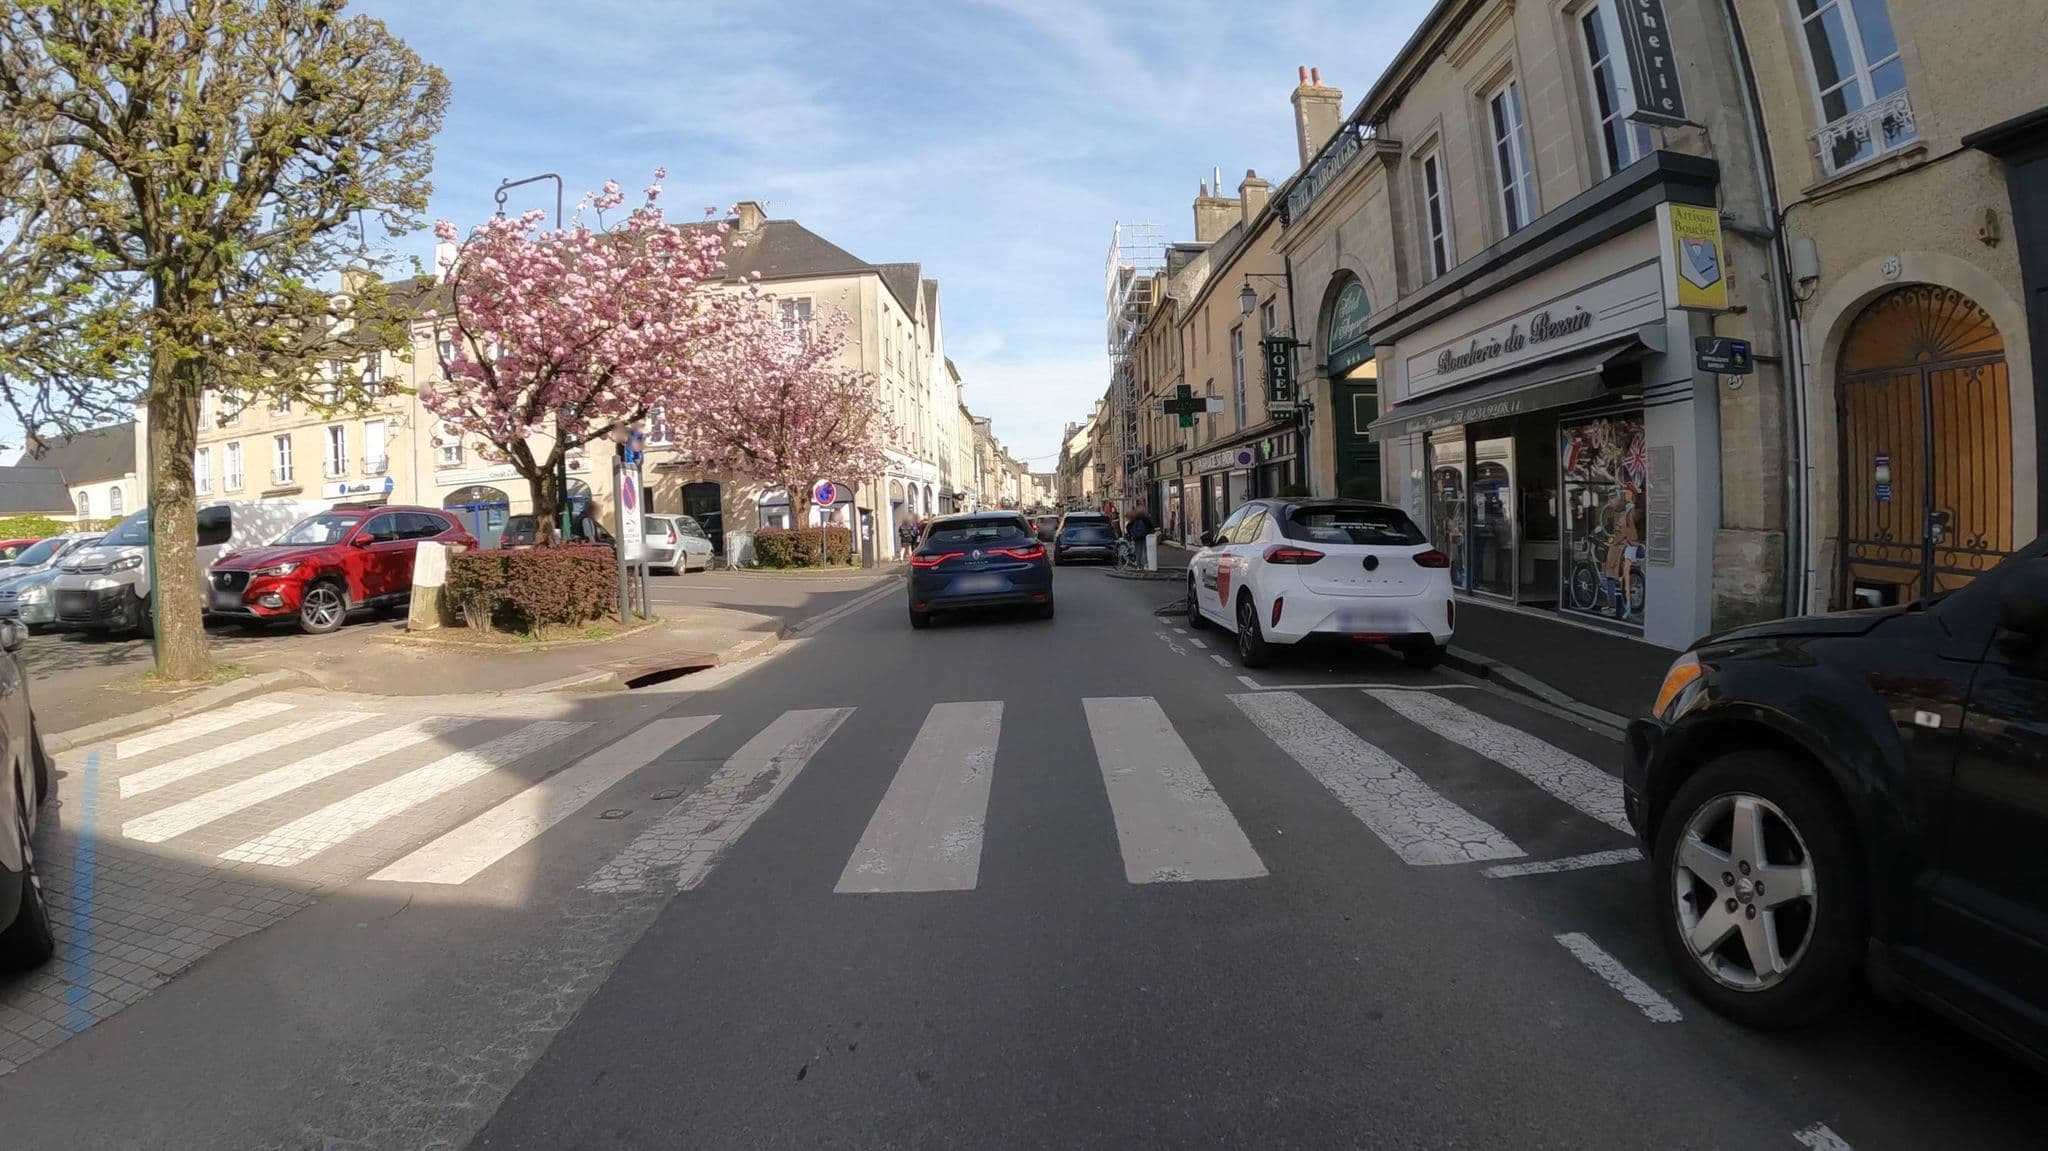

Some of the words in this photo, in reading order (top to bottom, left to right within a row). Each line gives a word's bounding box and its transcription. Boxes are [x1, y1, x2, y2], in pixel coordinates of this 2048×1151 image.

[1676, 208, 1713, 223] Artisan
[1674, 220, 1716, 237] Boucher
[1437, 338, 1502, 375] Boucherie
[1505, 324, 1526, 353] du
[1529, 305, 1593, 345] Bessin
[347, 484, 371, 493] Audika
